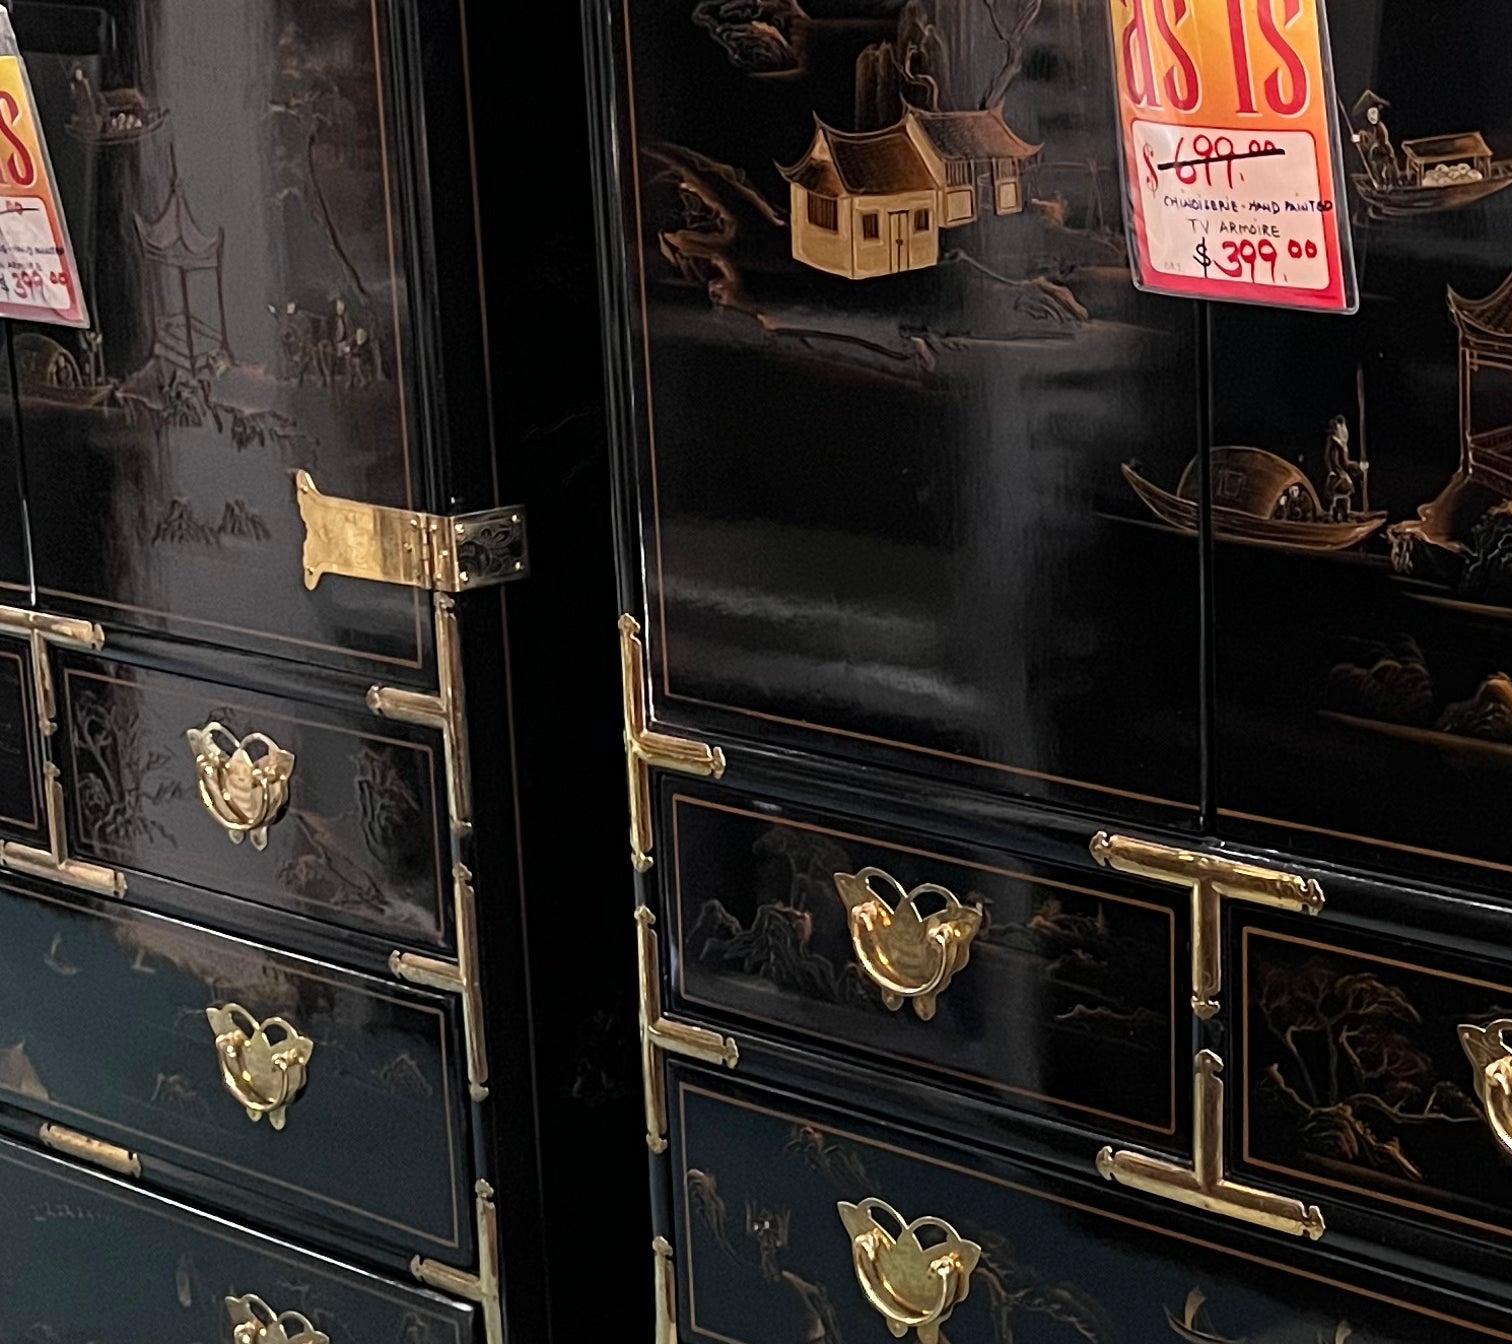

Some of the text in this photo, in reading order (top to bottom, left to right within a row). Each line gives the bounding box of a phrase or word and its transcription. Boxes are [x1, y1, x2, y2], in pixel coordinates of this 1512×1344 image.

[0, 90, 36, 187] s
[1188, 218, 1281, 237] TV ARMOIRE
